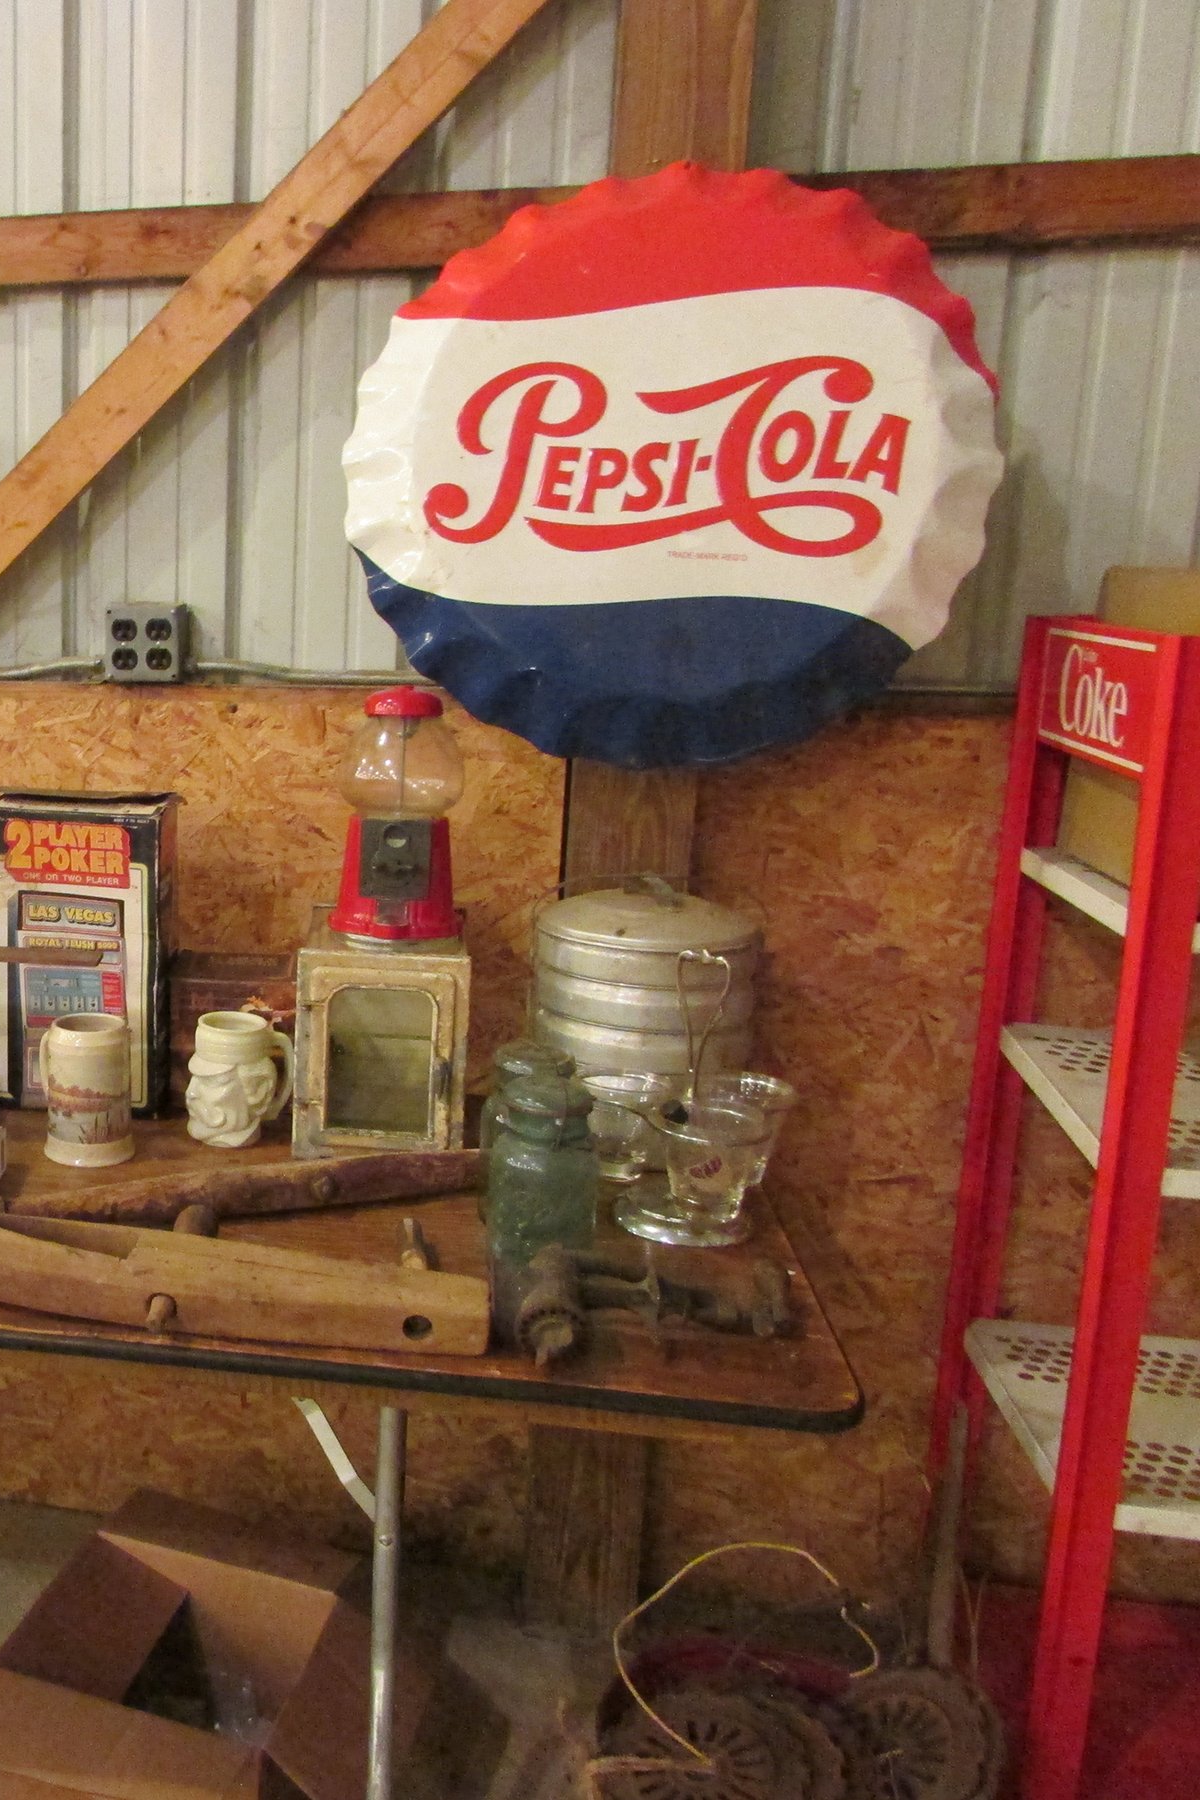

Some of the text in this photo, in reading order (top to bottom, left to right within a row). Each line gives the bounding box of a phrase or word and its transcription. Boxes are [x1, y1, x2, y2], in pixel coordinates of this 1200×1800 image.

[1059, 644, 1128, 748] Coke
[6, 820, 32, 869] 2
[32, 822, 123, 849] PLAYER
[34, 847, 124, 874] POKER
[22, 872, 40, 880] ONE
[62, 874, 82, 883] TWO
[86, 876, 119, 885] PLAYER
[28, 904, 115, 925] LAS VEGAS
